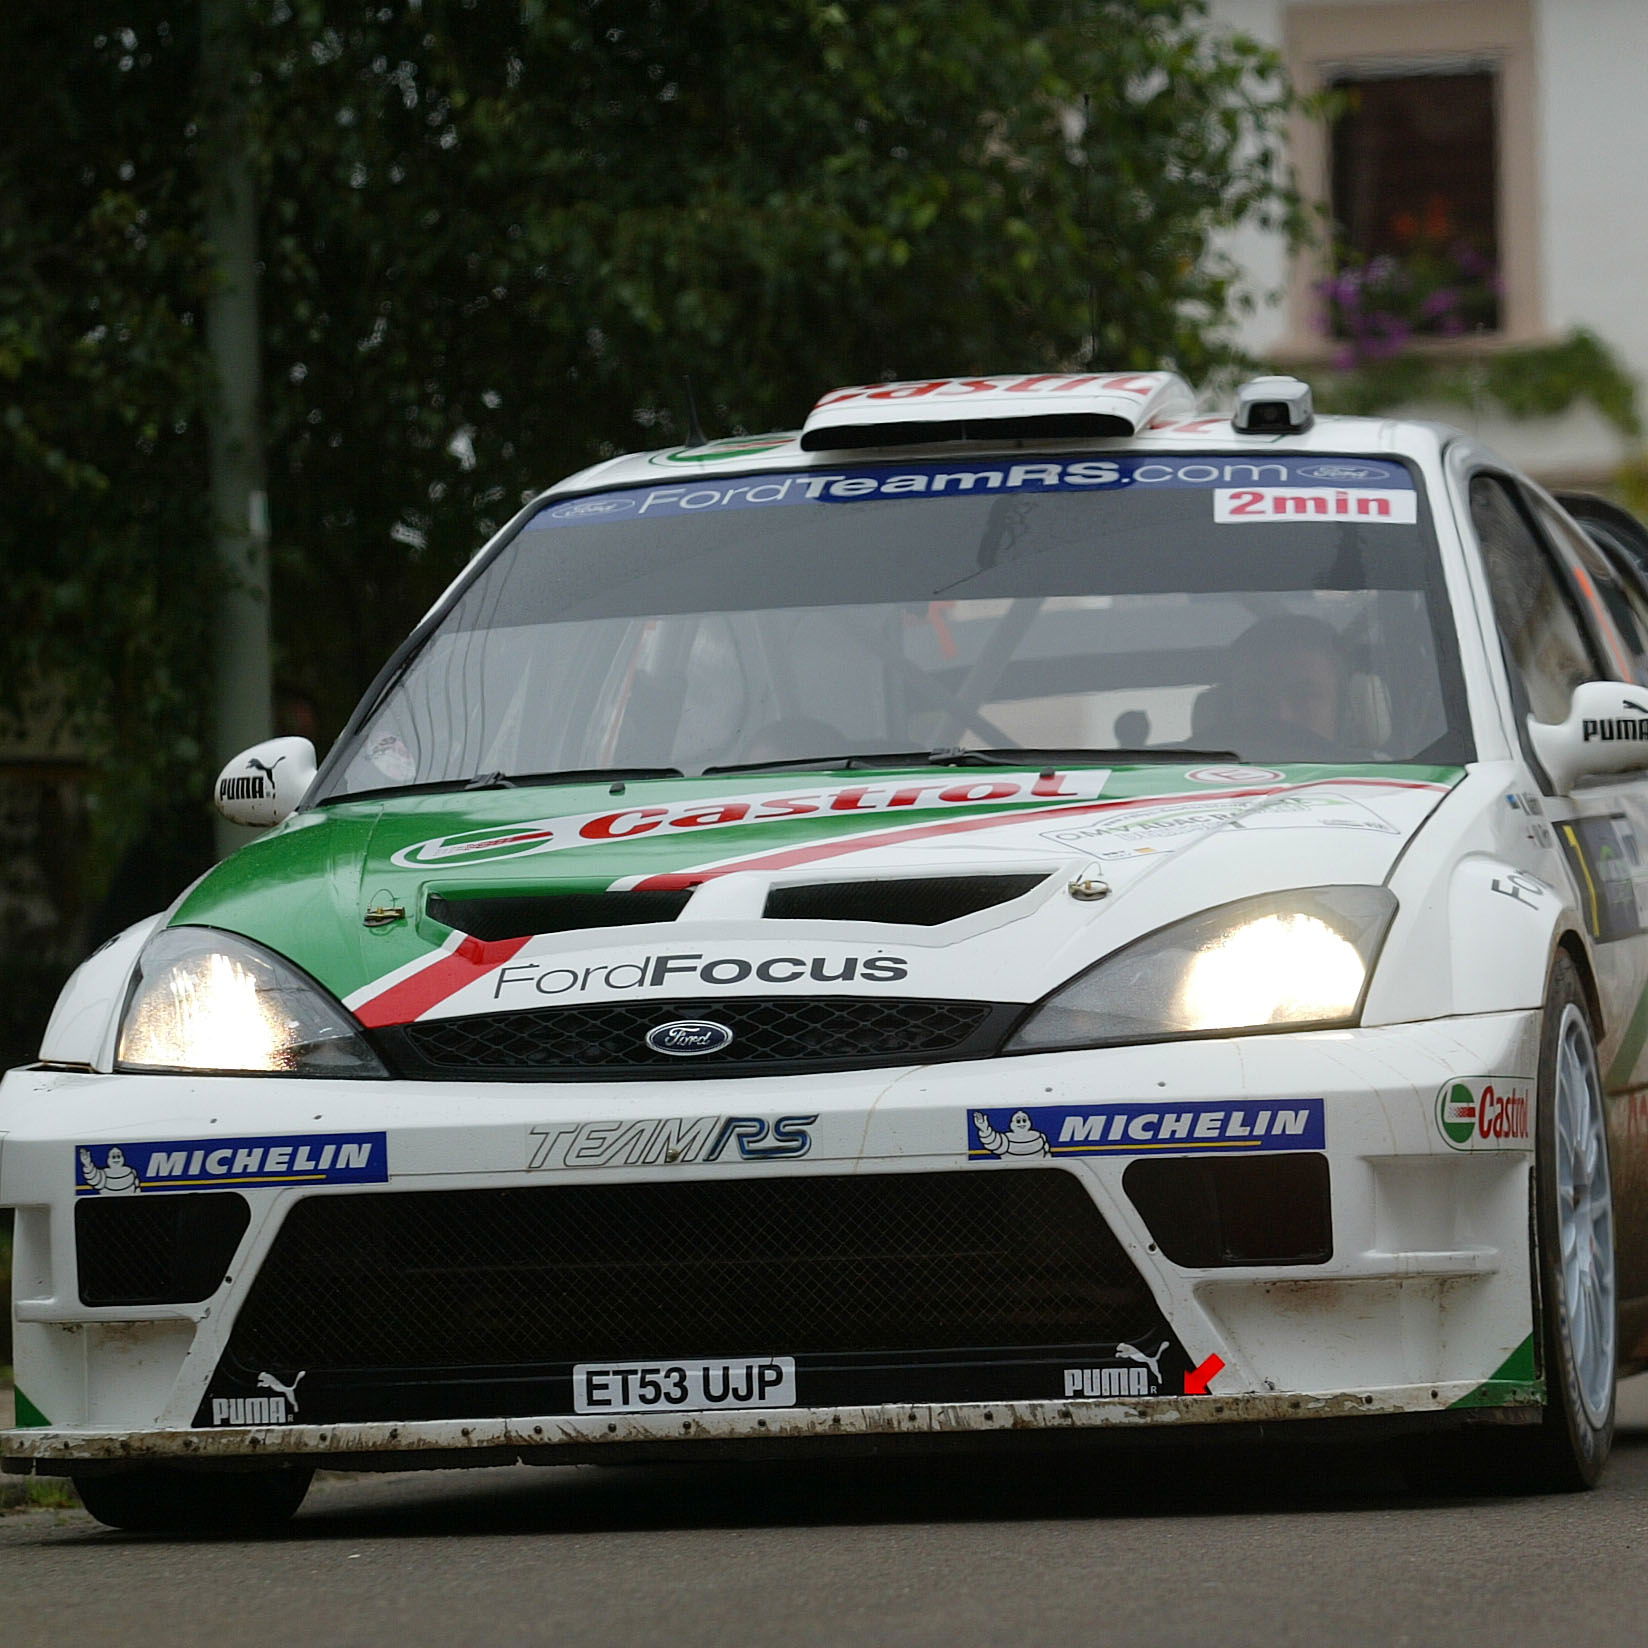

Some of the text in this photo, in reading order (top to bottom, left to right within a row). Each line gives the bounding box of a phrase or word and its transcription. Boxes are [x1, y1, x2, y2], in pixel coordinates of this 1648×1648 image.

[1313, 463, 1369, 480] Ford
[638, 461, 1288, 514] FordTeamRS.com
[1229, 490, 1391, 517] 2min
[220, 776, 264, 801] PUMA
[579, 774, 1078, 839] Castrol
[1055, 825, 1130, 841] OMV
[494, 953, 907, 1000] FordFocus
[665, 1027, 711, 1046] Ford
[1058, 1109, 1310, 1142] MICHELIN
[1478, 1085, 1529, 1139] Castrol
[145, 1142, 373, 1178] MICHELIN
[585, 1363, 784, 1407] ET53 UJP
[1064, 1368, 1149, 1396] PUMA
[212, 1397, 286, 1425] PUMA
